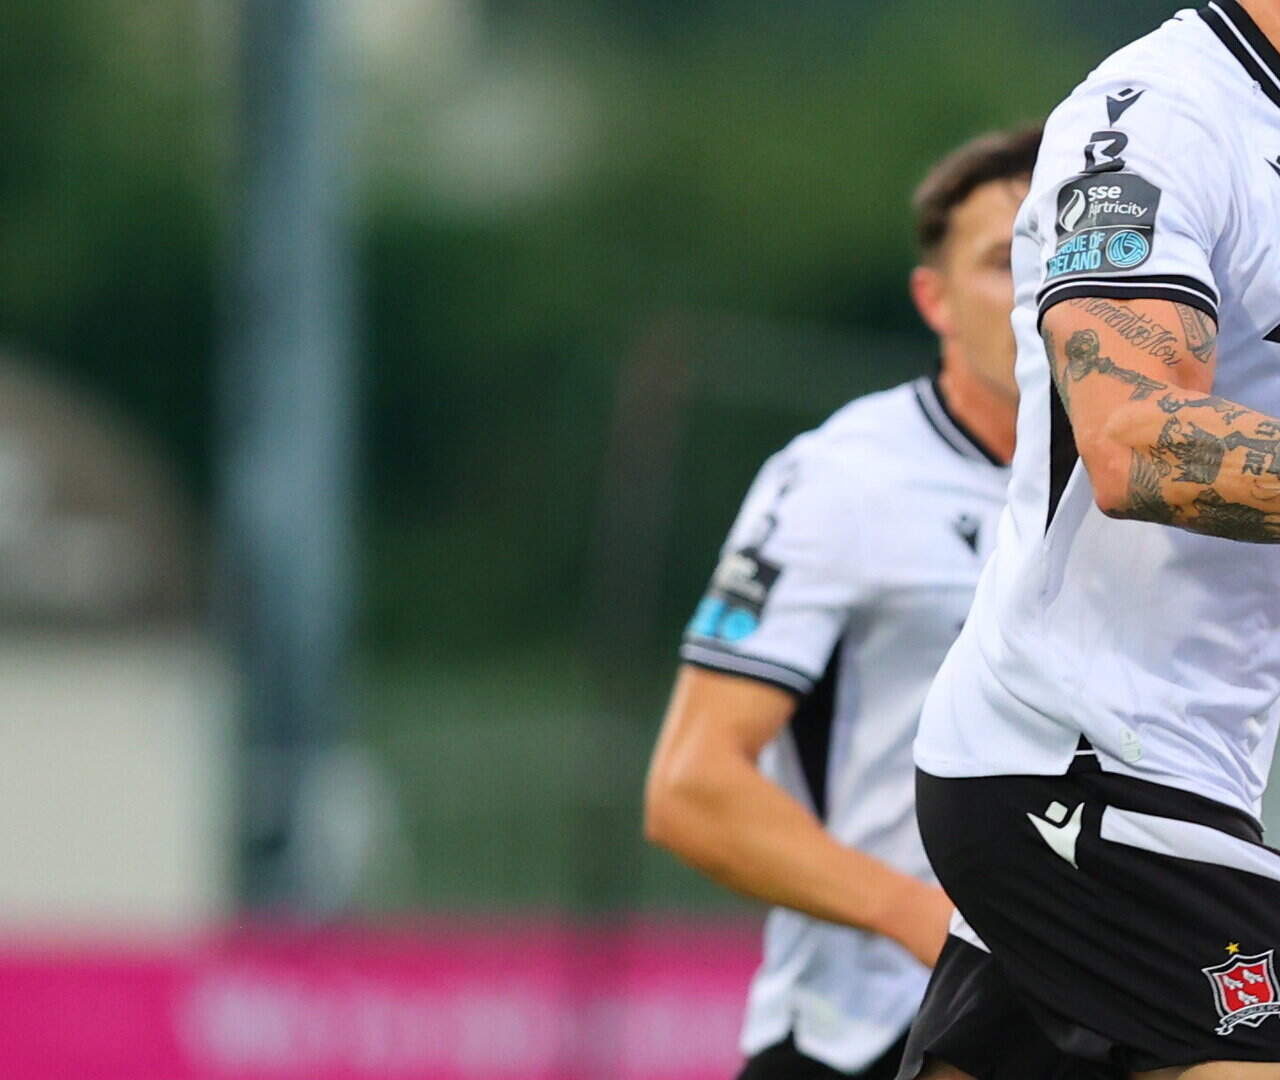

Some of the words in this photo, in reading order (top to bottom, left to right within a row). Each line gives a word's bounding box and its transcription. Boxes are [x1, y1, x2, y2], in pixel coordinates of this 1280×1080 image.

[1087, 185, 1122, 202] sse
[1088, 201, 1148, 219] Airtricity
[1088, 230, 1105, 248] OF
